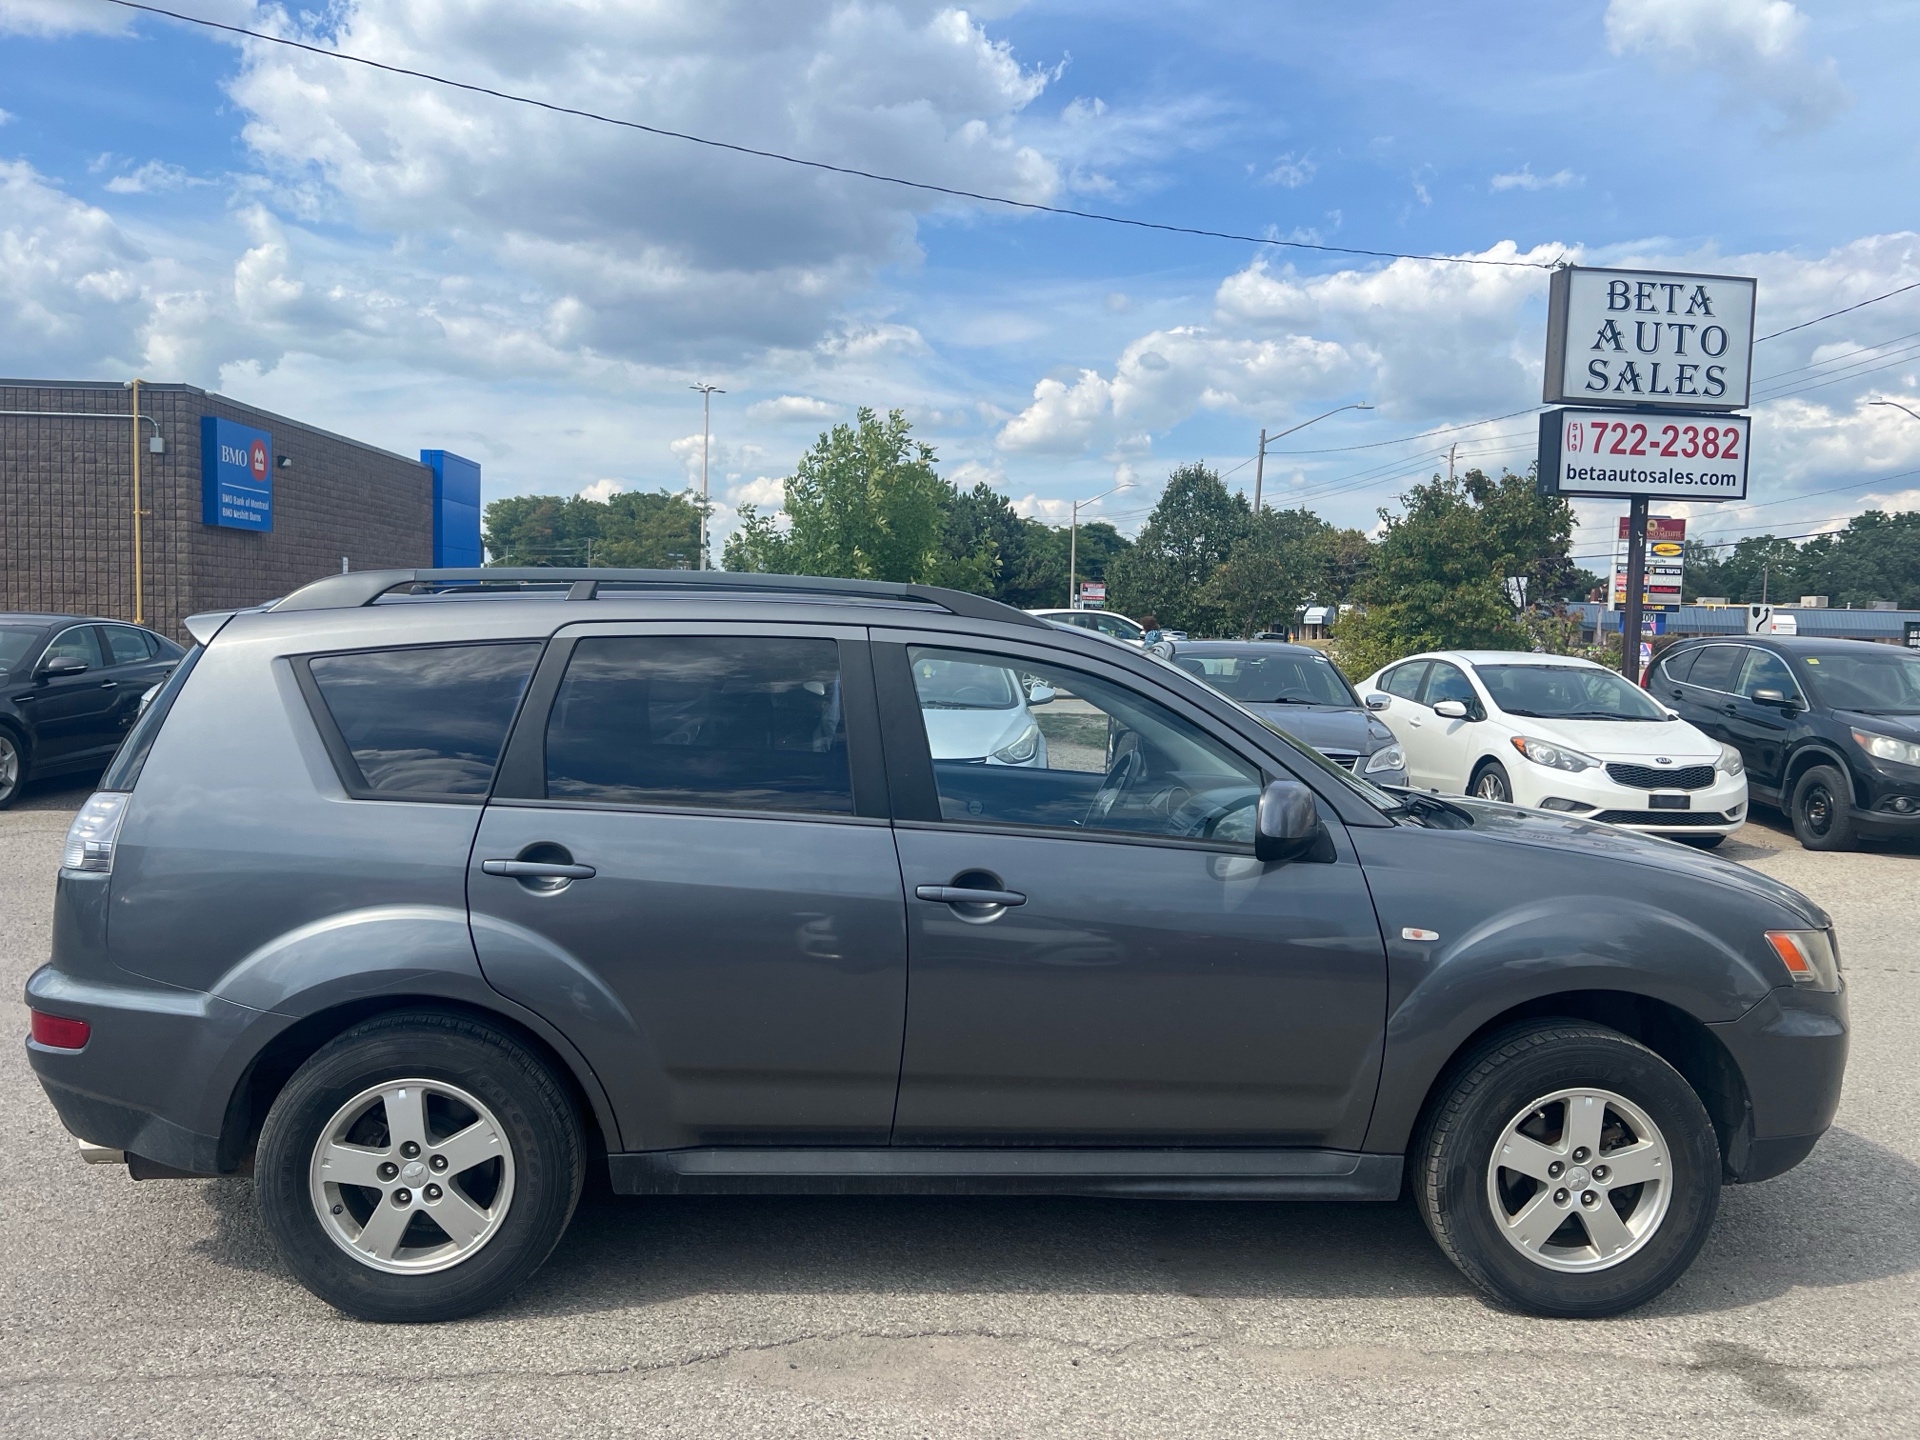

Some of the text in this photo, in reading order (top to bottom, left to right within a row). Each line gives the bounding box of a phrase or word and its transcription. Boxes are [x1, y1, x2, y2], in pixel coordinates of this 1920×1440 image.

[1606, 279, 1715, 317] BETA
[1590, 319, 1730, 358] AUTO
[1585, 358, 1728, 397] SALES
[221, 445, 248, 467] BMO
[1590, 421, 1740, 460] 722-2382
[1566, 463, 1737, 487] betaautosales.com
[222, 494, 269, 510] BMO Bank of Montreal
[222, 508, 232, 518] BMO
